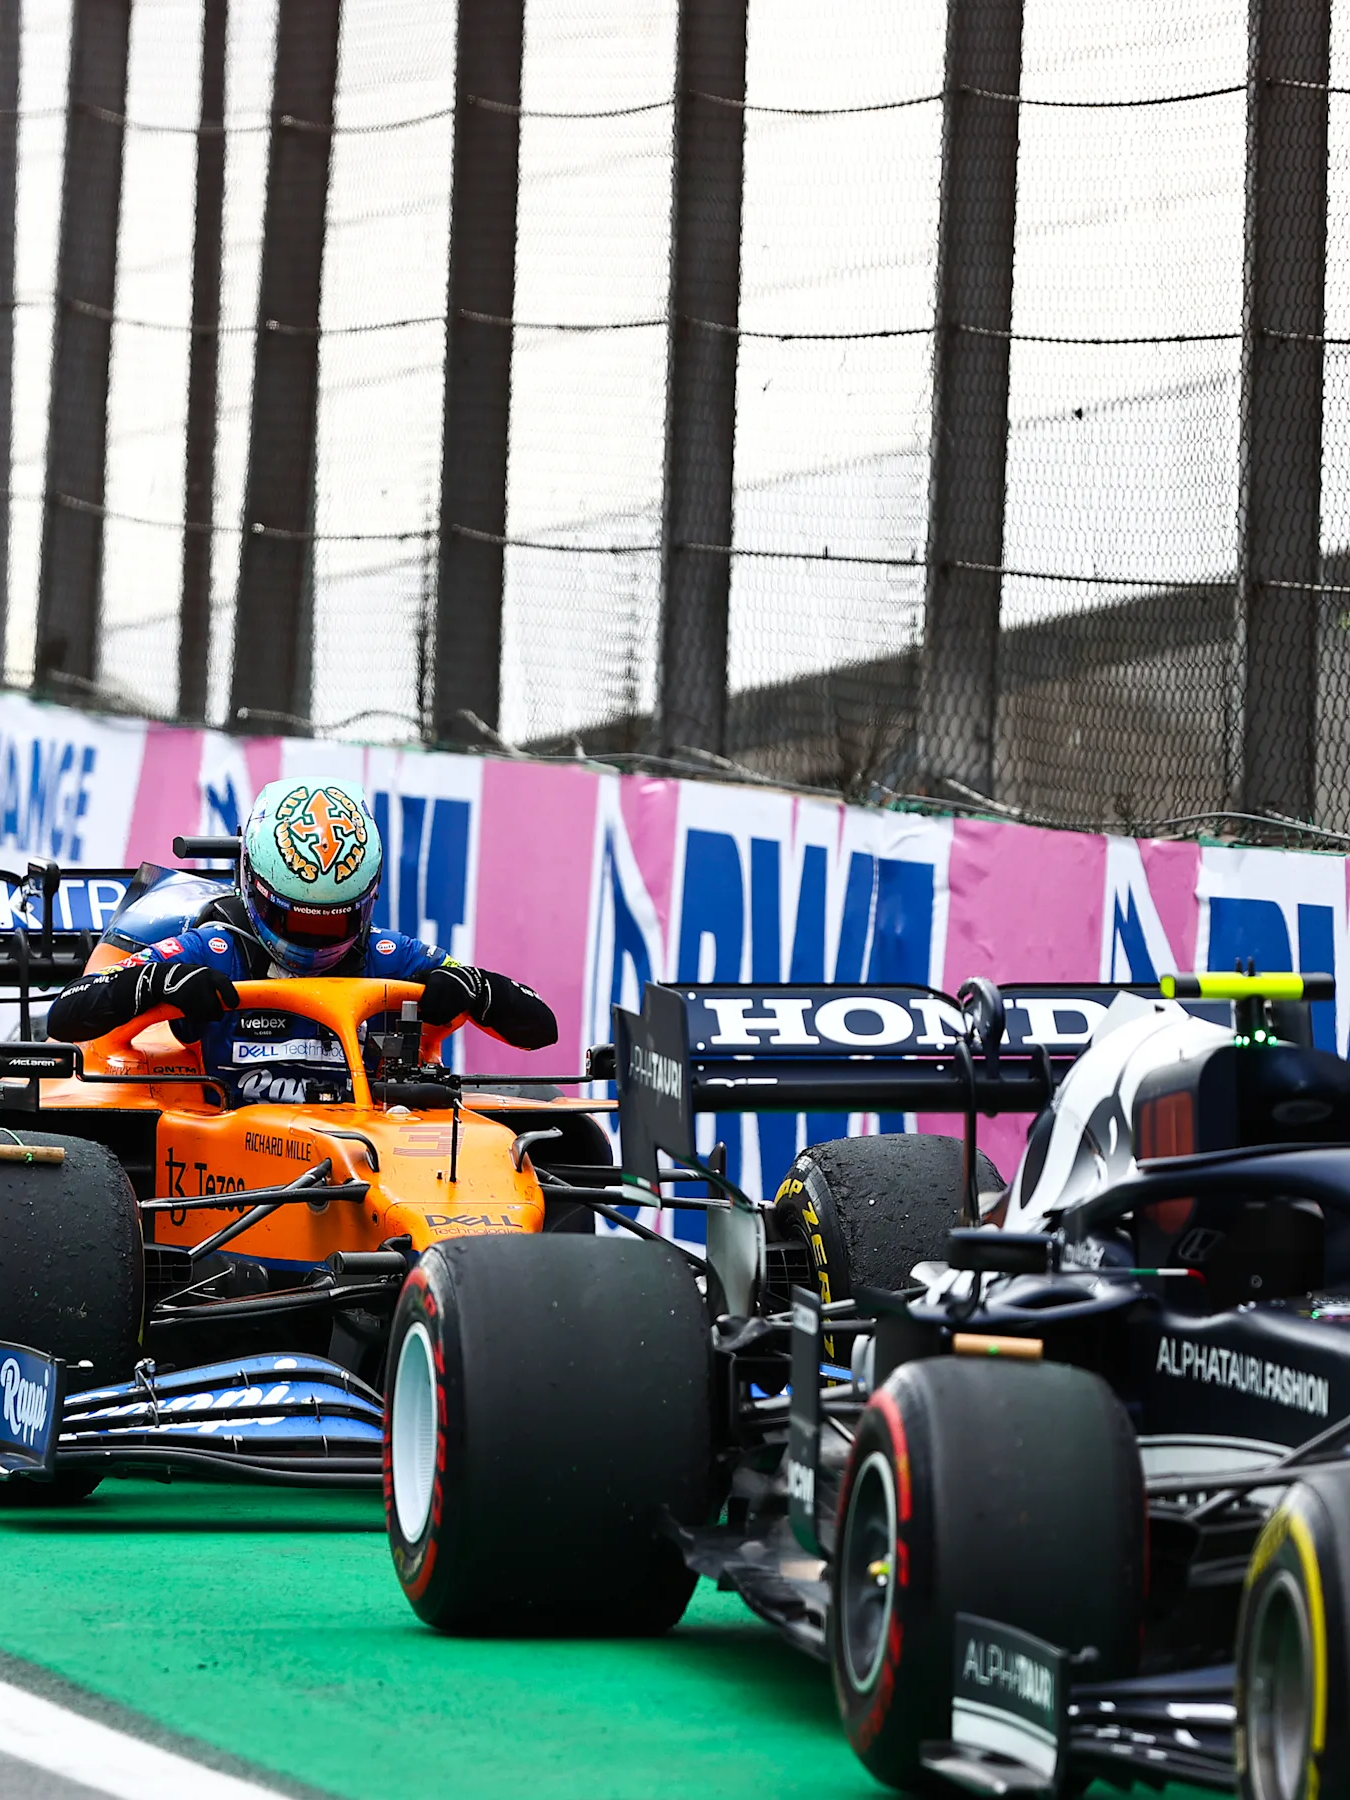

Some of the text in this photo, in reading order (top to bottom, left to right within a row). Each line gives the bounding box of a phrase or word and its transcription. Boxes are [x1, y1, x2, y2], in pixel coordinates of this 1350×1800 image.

[293, 905, 321, 916] webex
[323, 909, 330, 917] by
[240, 1015, 287, 1030] webex
[703, 997, 1110, 1046] HOND
[238, 1044, 280, 1058] DELL
[8, 1057, 56, 1067] McLaren
[152, 1065, 198, 1075] QNTM
[245, 1131, 312, 1163] RICHARD MILLE
[393, 1126, 466, 1158] 3
[425, 1213, 524, 1229] DELL
[1155, 1334, 1330, 1418] ALPHATAURI.FASHION
[0, 1357, 50, 1446] Rappi
